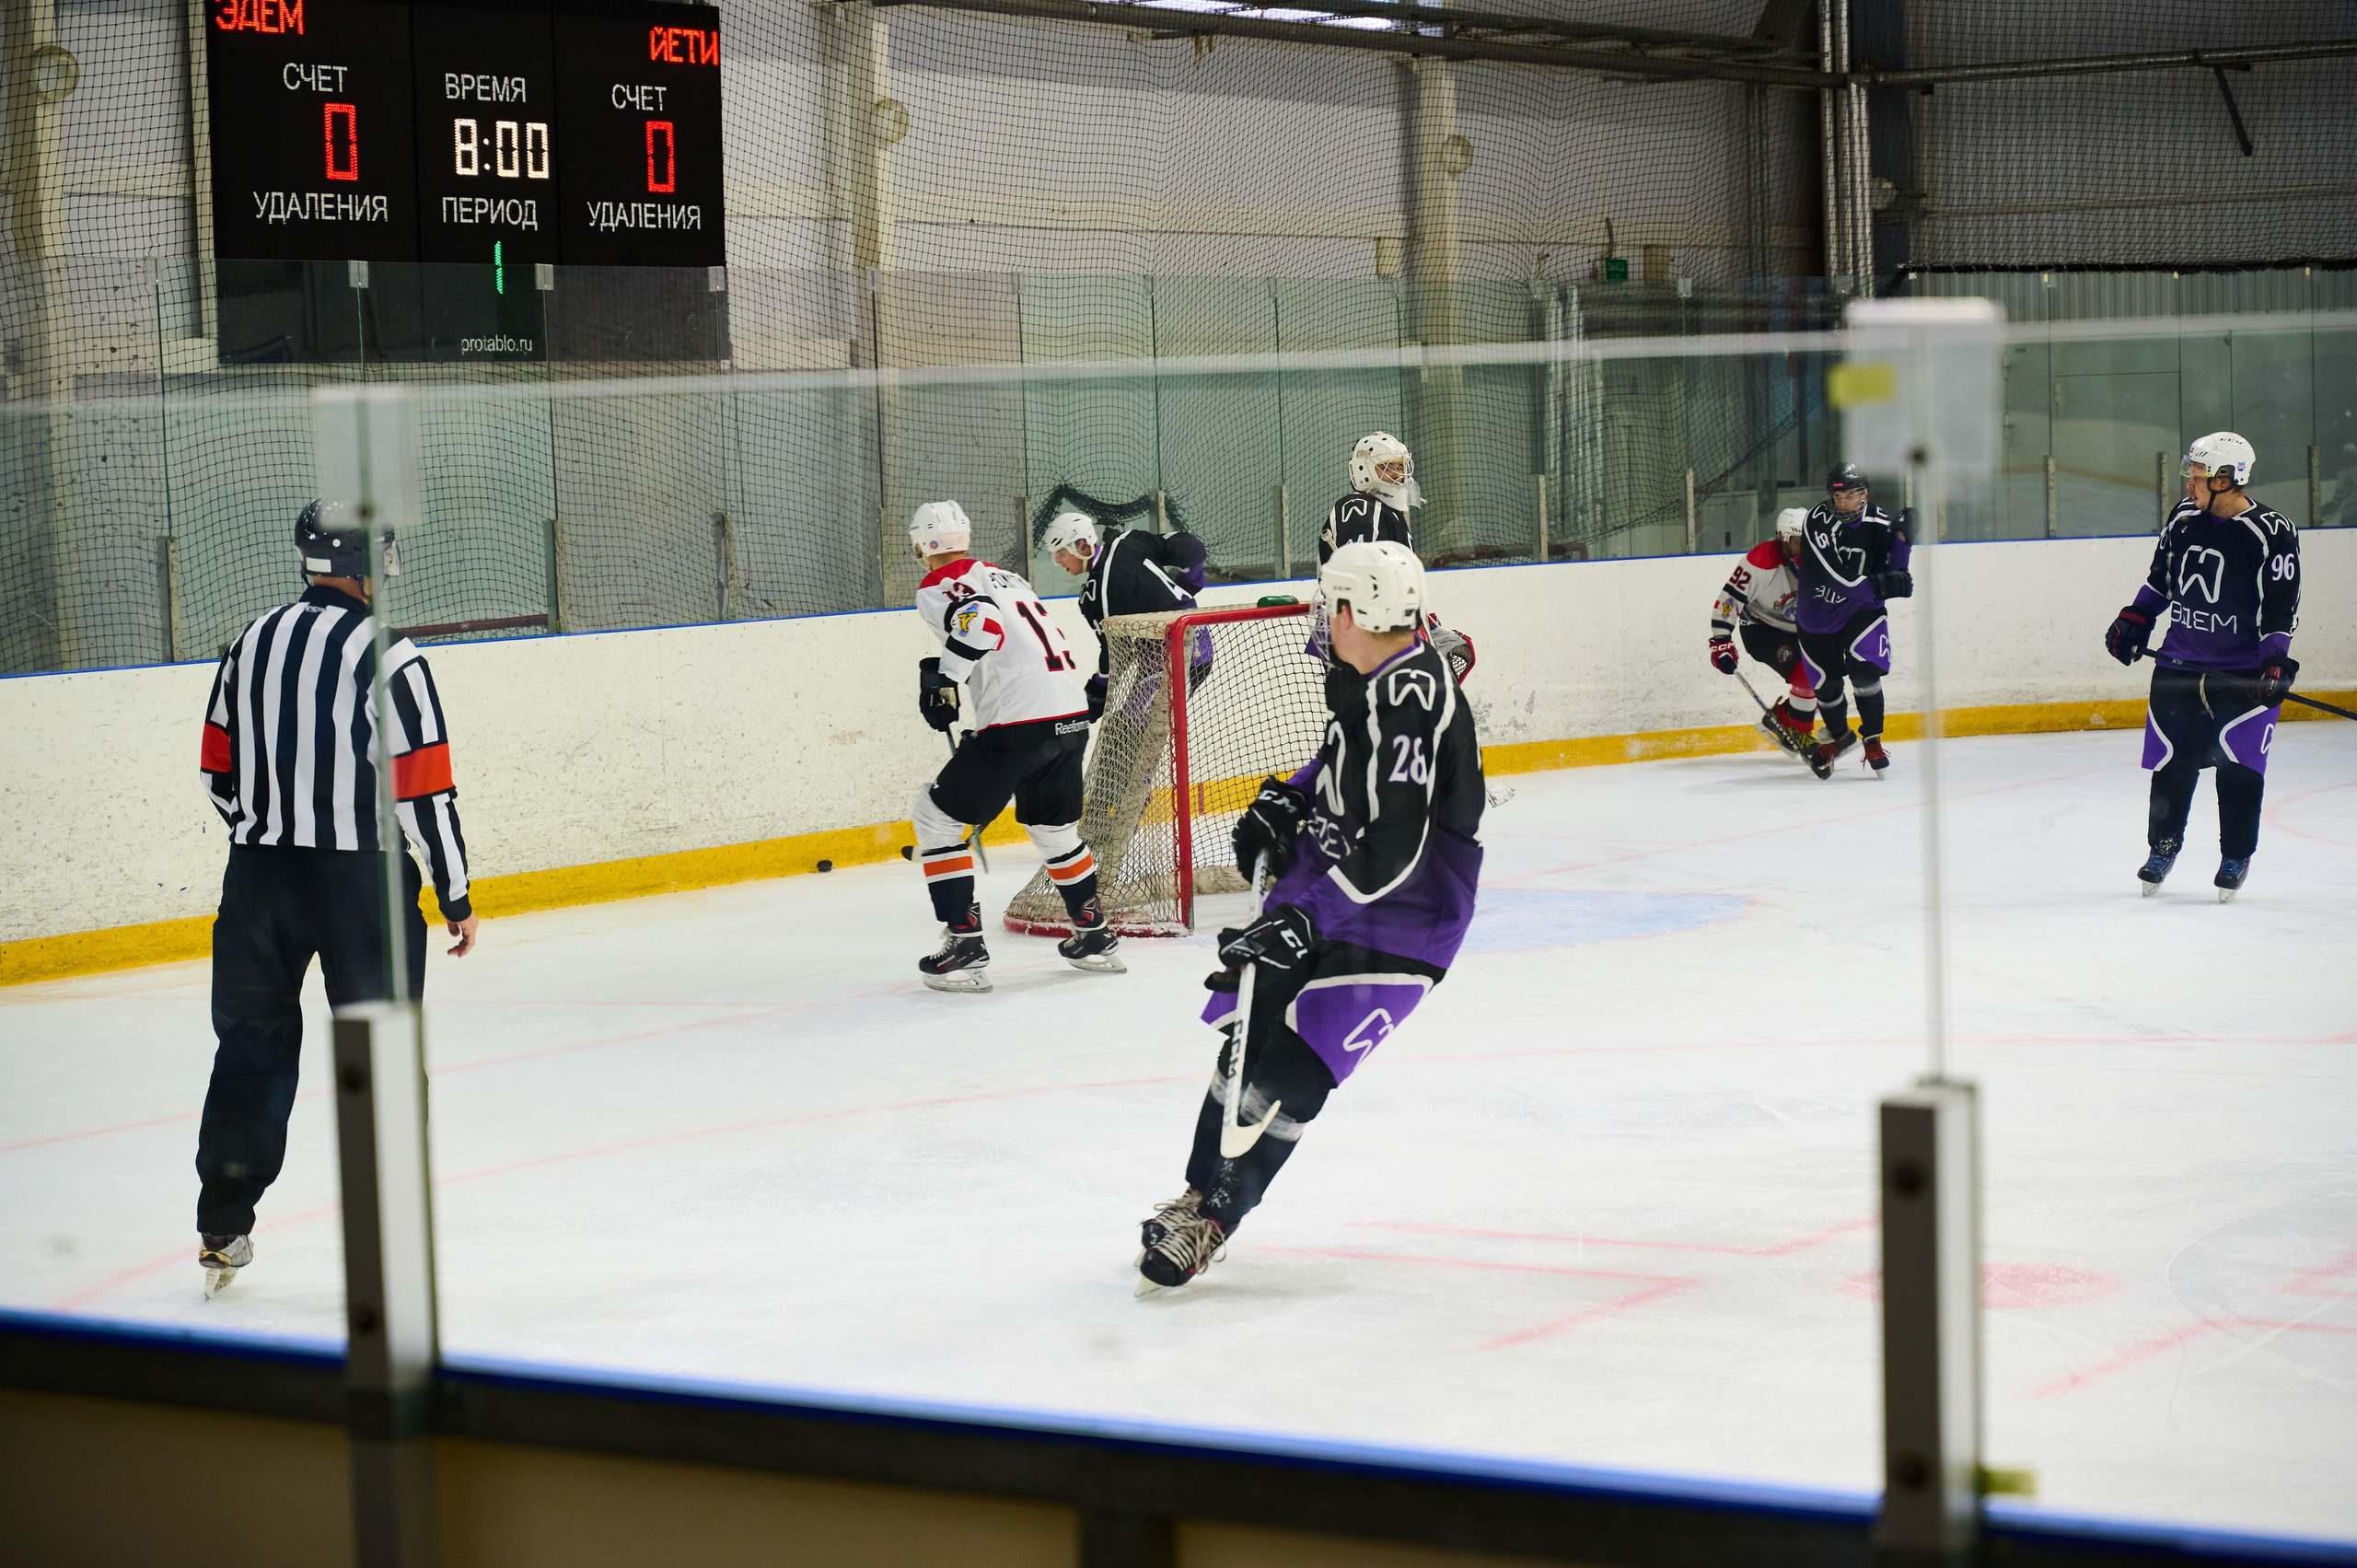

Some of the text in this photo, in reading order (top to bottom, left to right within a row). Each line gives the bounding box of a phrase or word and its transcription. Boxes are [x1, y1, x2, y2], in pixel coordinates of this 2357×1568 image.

[215, 0, 304, 35] ЭДЕМ
[649, 26, 718, 65] ЙЕТИ
[283, 63, 348, 93] СЧЕТ
[445, 73, 526, 103] ВРЕМЯ
[611, 84, 667, 111] СЧЕТ
[324, 103, 358, 180] 0
[454, 118, 550, 180] 8:00
[645, 120, 675, 192] 0
[253, 192, 389, 224] УДАЛЕНИЯ
[442, 197, 538, 231] ПЕРИОД
[587, 201, 701, 232] УДАЛЕНИЯ
[494, 241, 504, 294] 1
[461, 334, 533, 355] protablo.ru
[1729, 565, 1752, 591] 92
[2271, 553, 2295, 582] 96
[1388, 734, 1428, 784] 28
